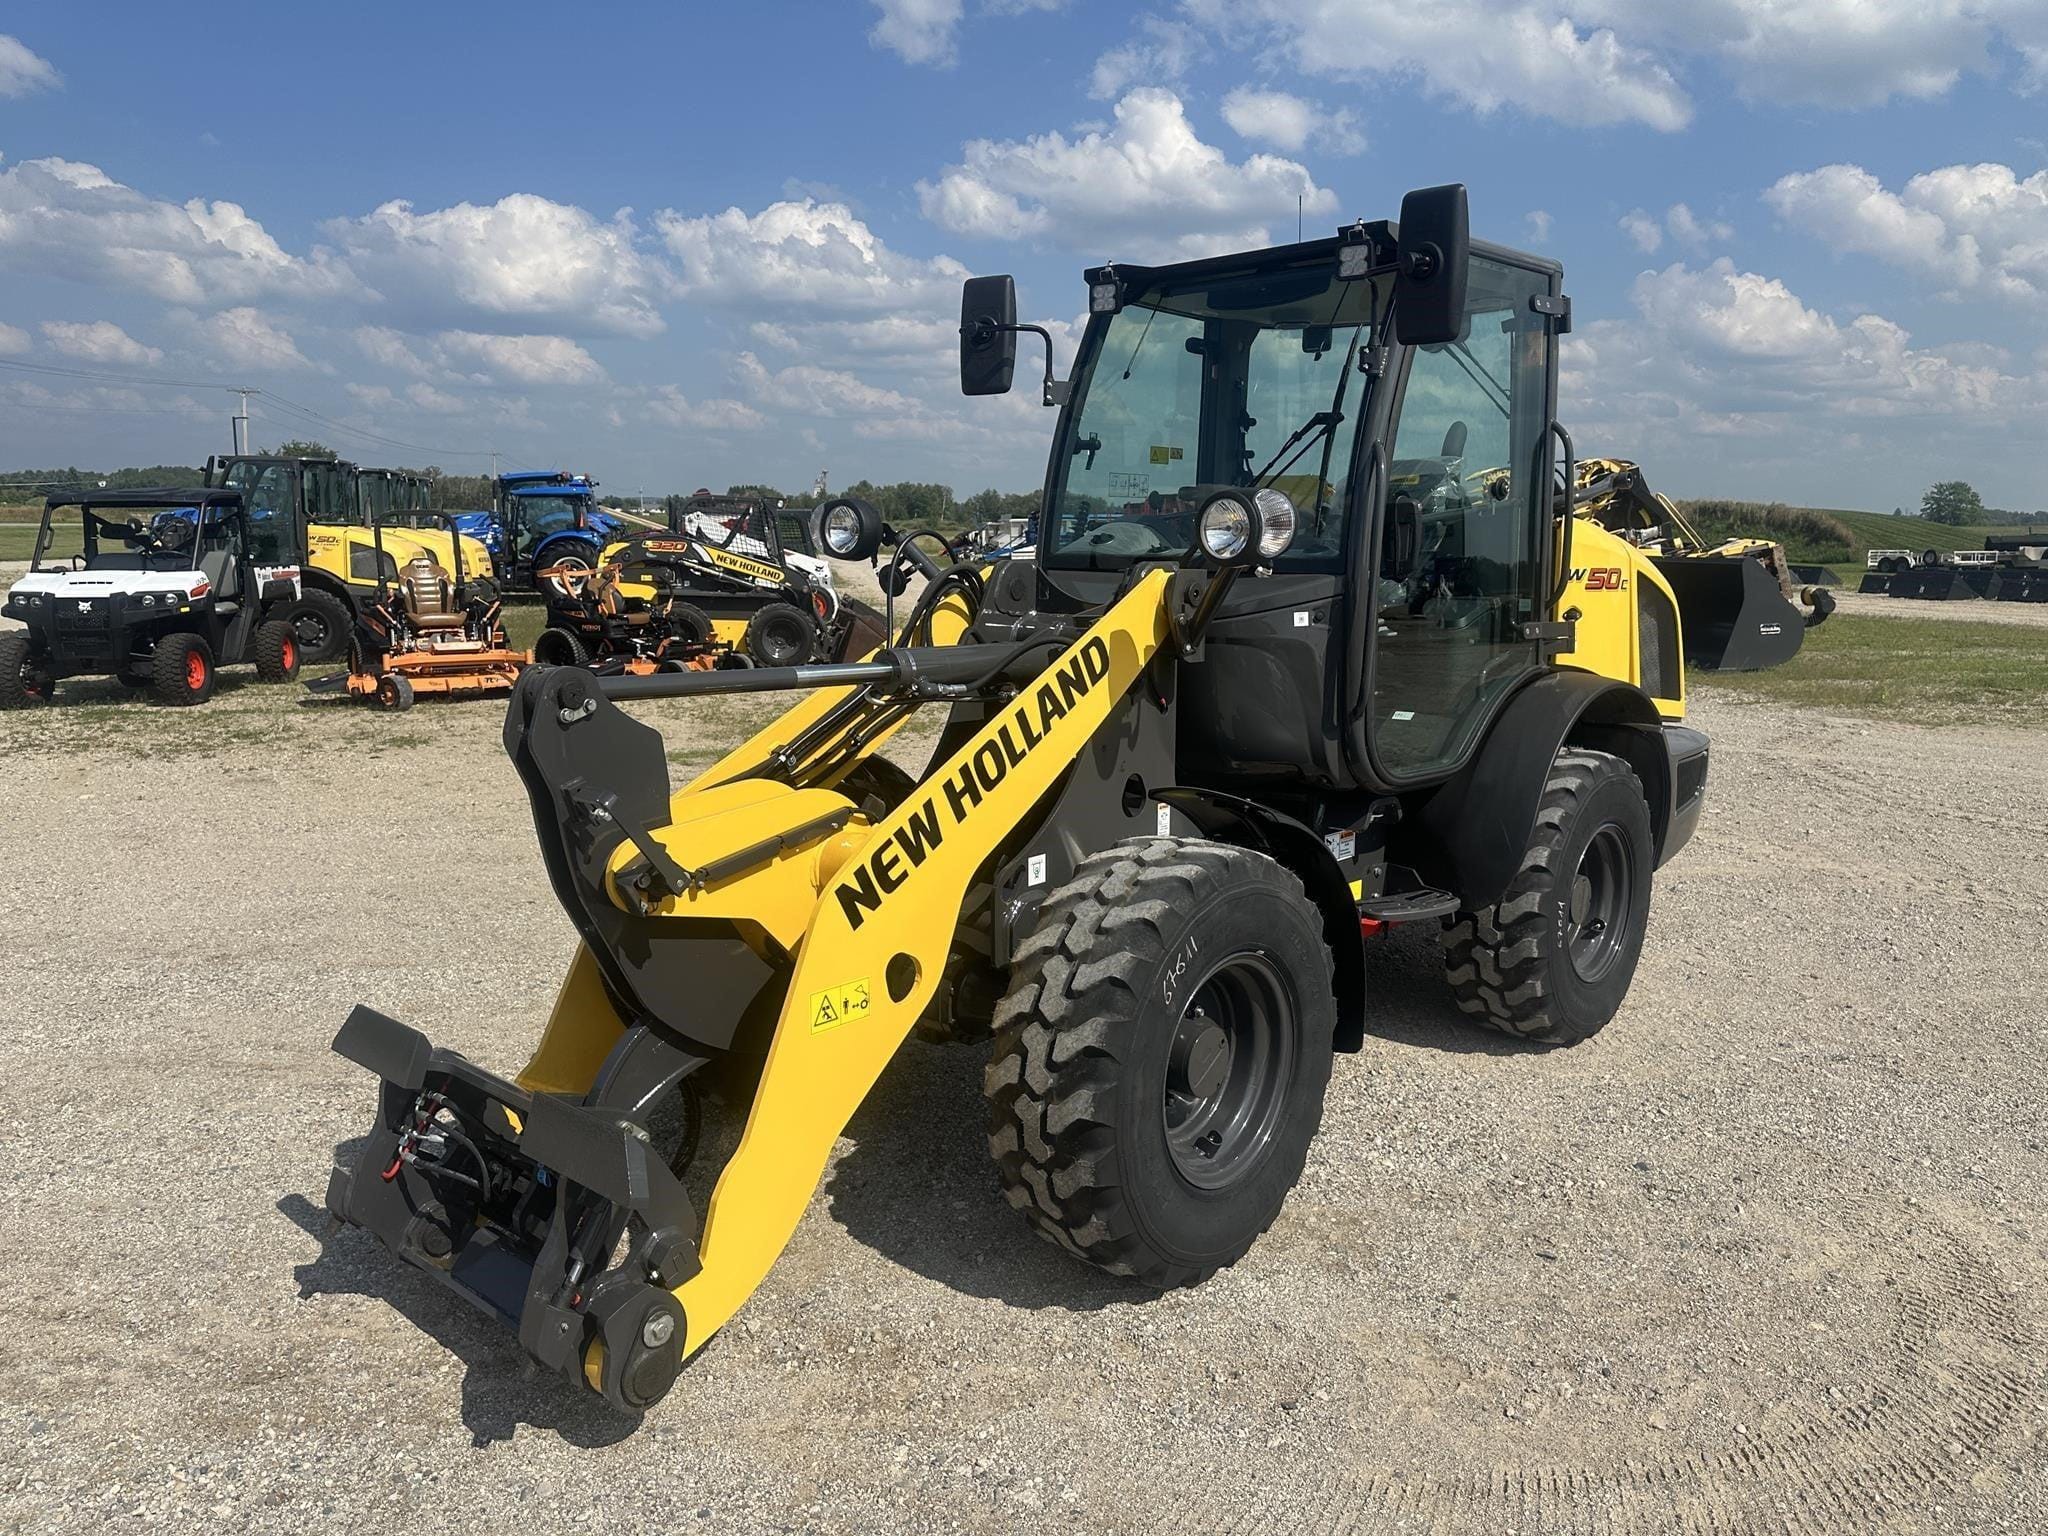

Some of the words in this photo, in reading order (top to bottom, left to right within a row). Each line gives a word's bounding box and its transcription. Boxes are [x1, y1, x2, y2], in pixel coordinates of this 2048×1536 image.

[716, 553, 738, 567] NEW
[739, 559, 782, 580] HOLLAND
[834, 797, 943, 931] NEW
[942, 635, 1110, 825] HOLLAND
